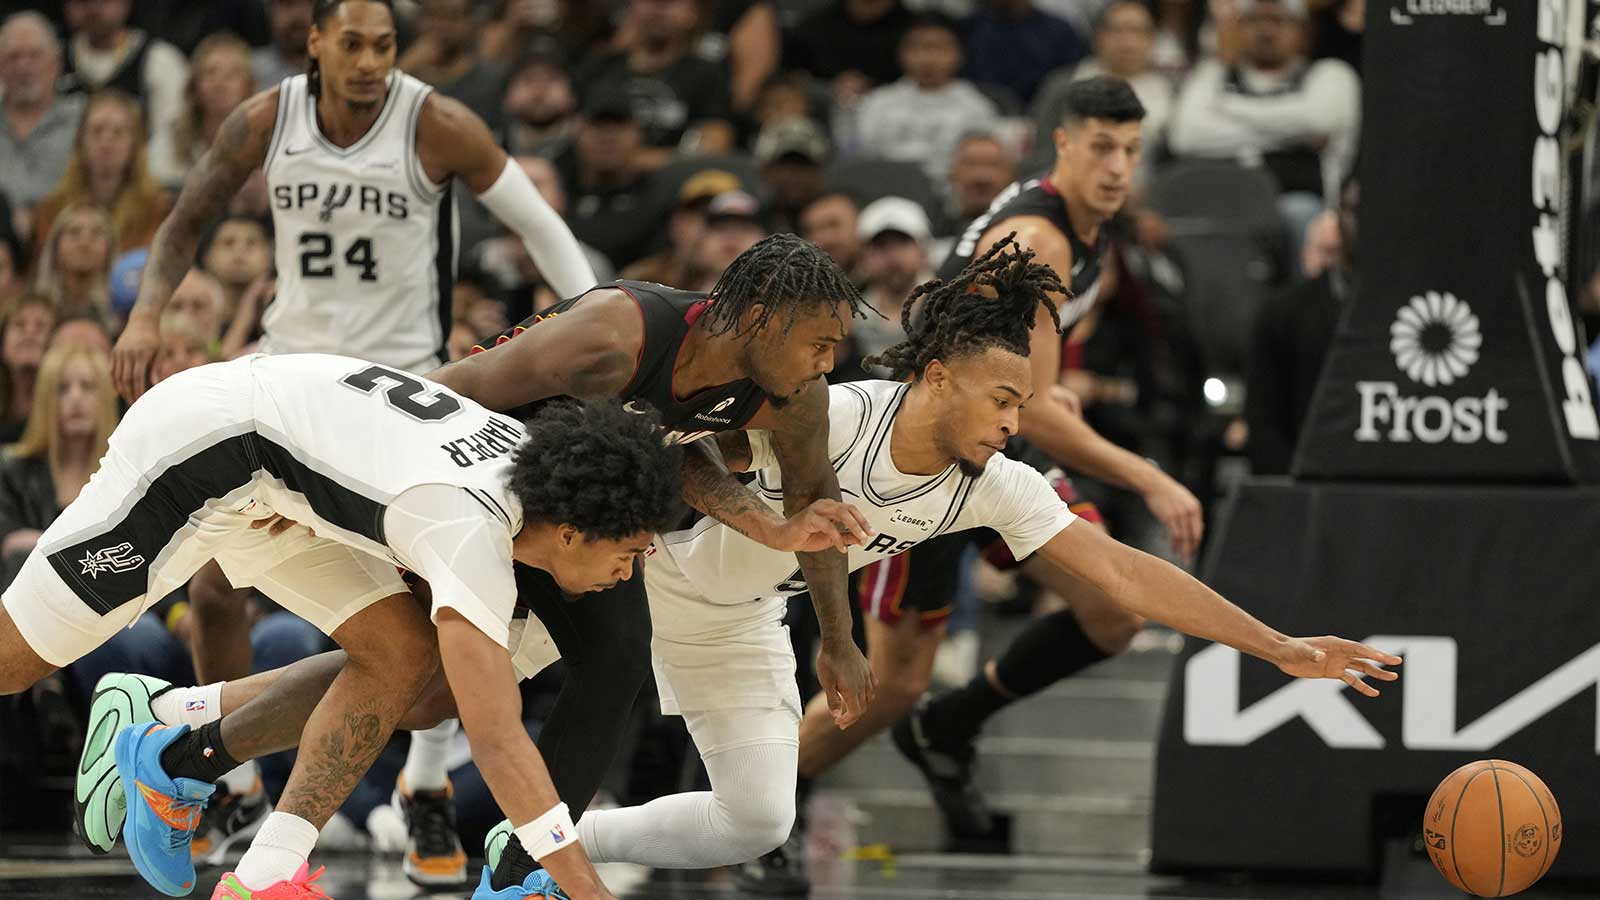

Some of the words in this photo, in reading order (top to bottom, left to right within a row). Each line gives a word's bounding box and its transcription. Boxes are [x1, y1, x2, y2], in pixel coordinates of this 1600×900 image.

[275, 183, 408, 222] SPURS
[299, 232, 378, 283] 24
[338, 364, 466, 424] 2
[694, 412, 732, 424] Robinhood
[1353, 380, 1509, 444] Frost
[440, 416, 522, 468] HARPER
[897, 513, 927, 527] LEDGER
